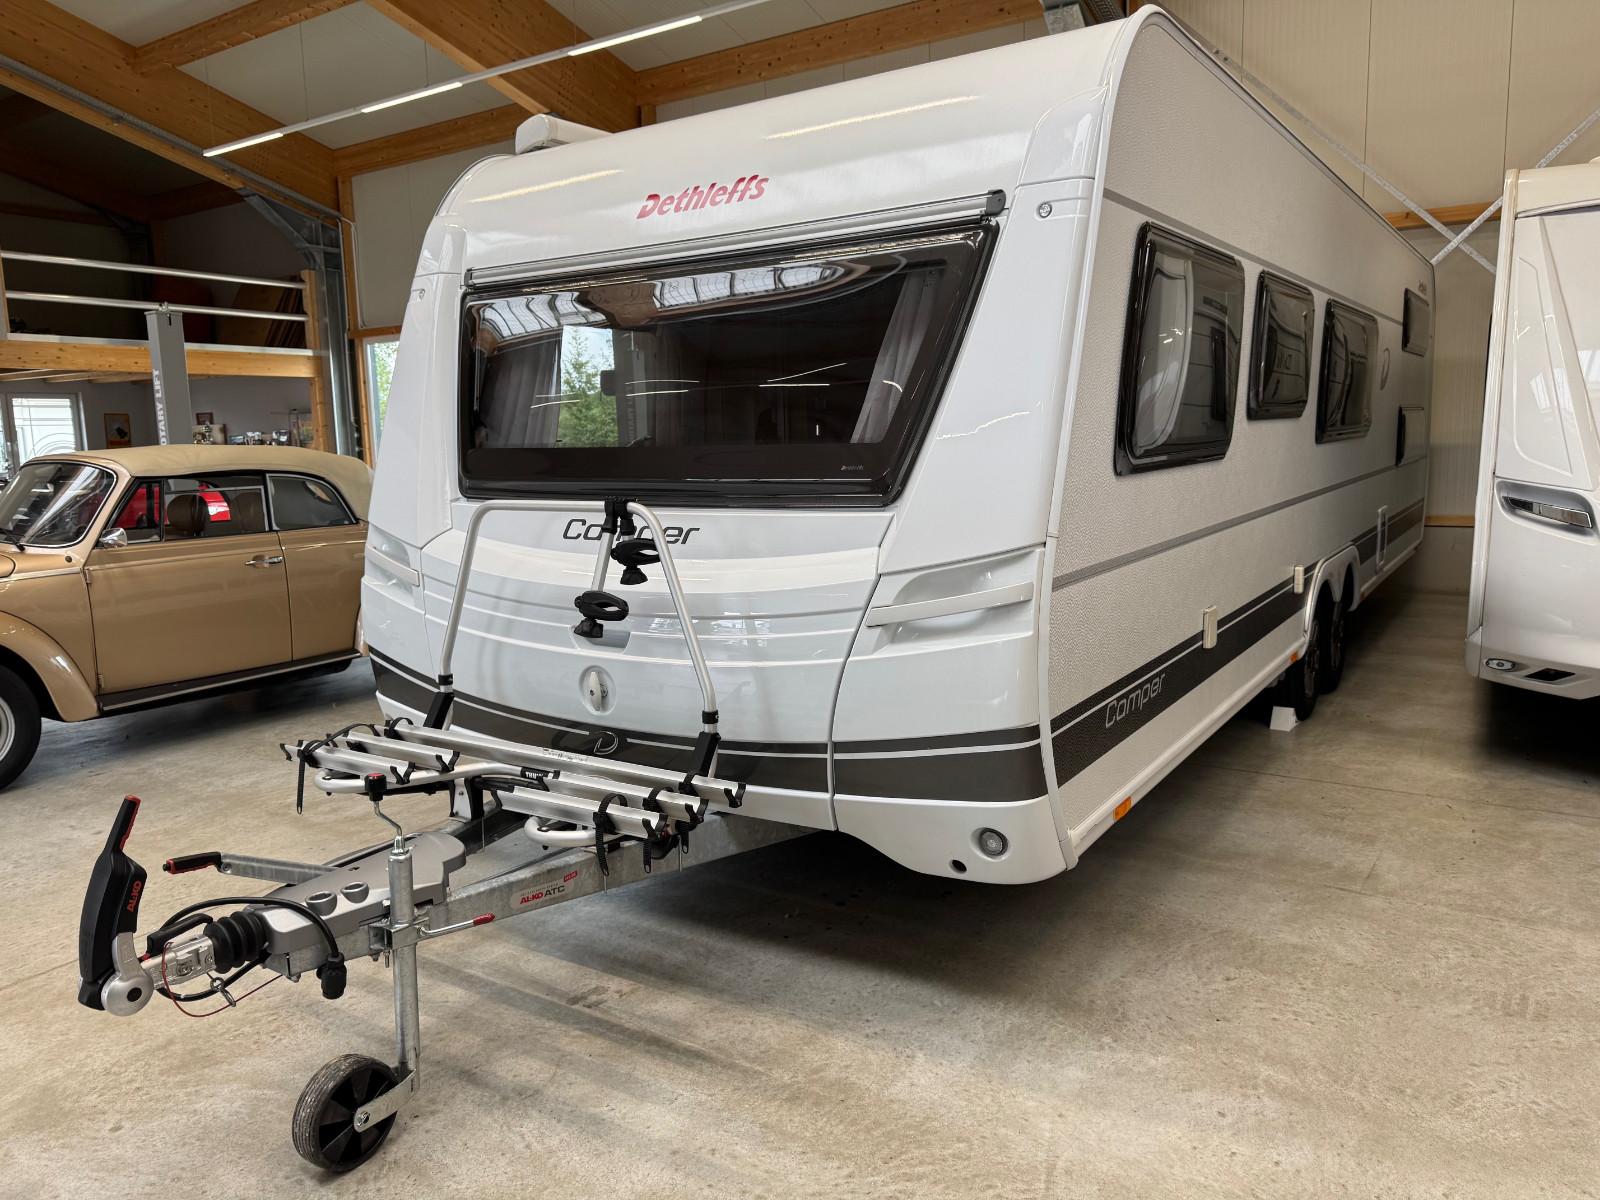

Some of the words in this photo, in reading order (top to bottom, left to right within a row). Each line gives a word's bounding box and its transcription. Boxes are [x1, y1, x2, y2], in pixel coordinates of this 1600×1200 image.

[636, 174, 769, 219] Dethleffs
[152, 368, 162, 398] LIFT
[155, 401, 167, 446] OTARY
[562, 518, 701, 545] Caer
[1105, 673, 1166, 729] Camper
[544, 885, 566, 897] ATC
